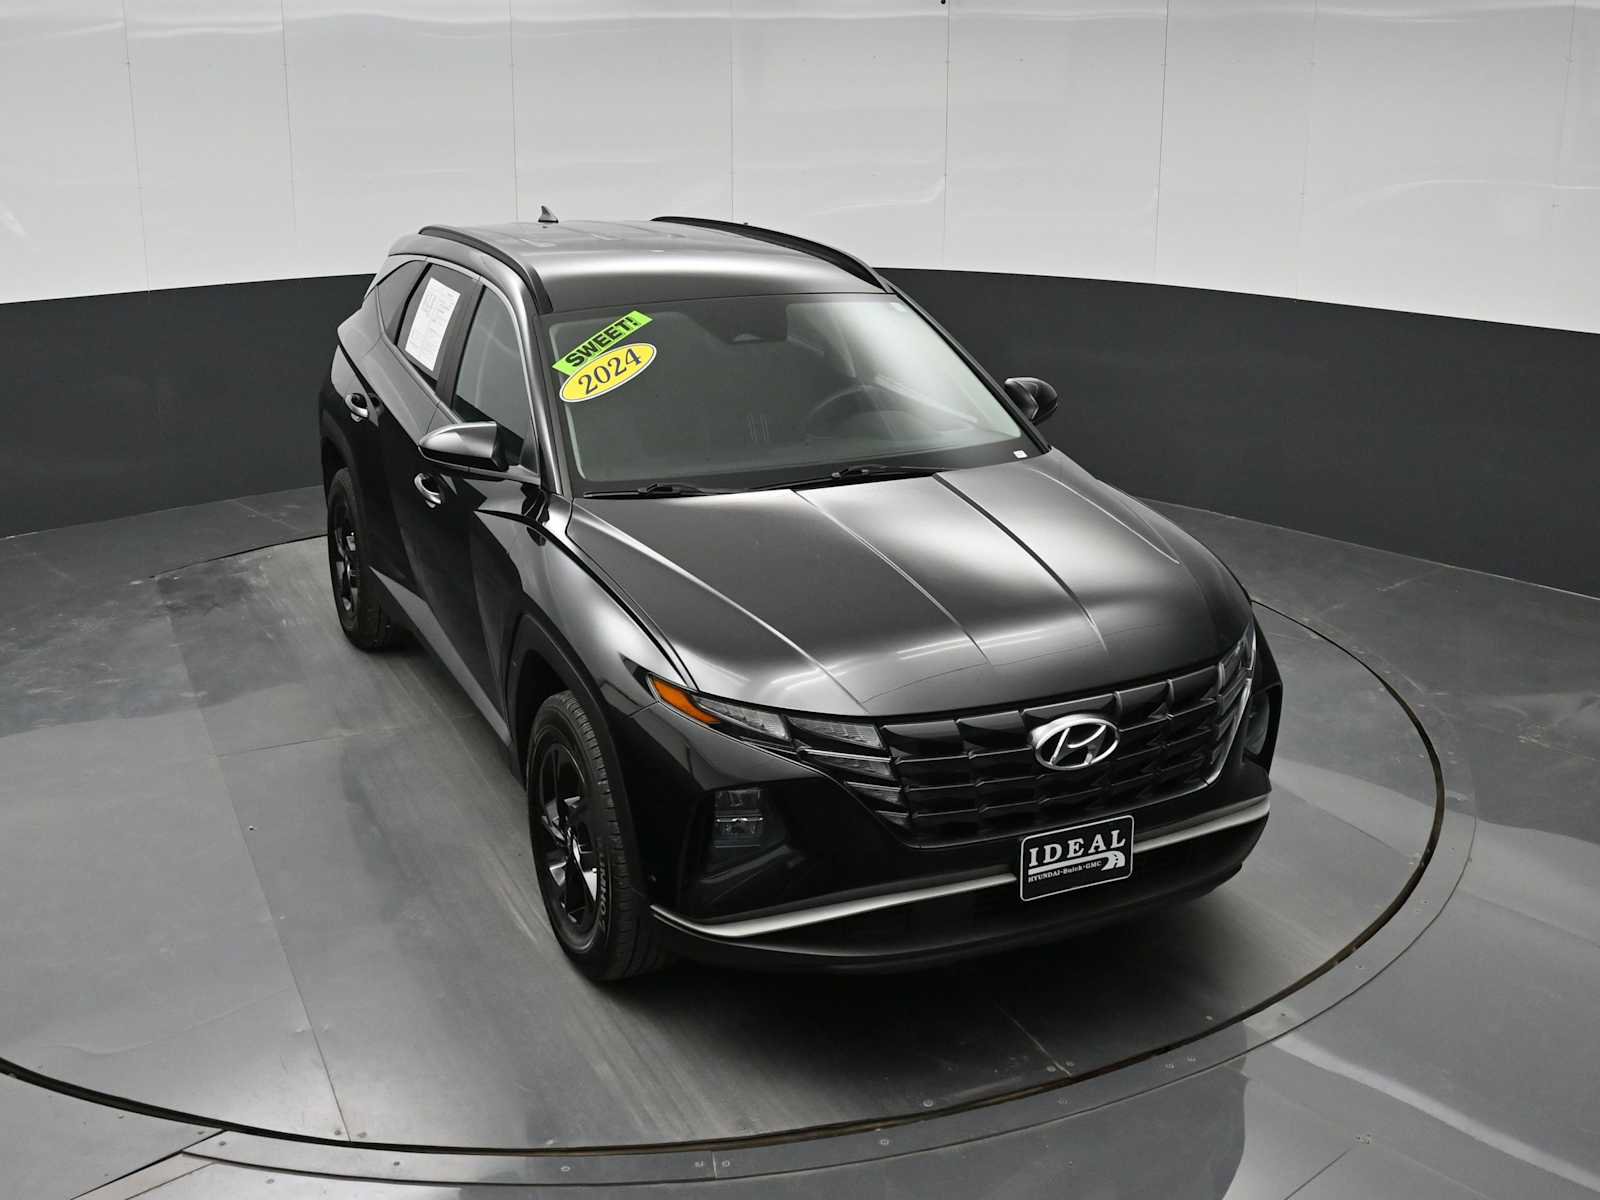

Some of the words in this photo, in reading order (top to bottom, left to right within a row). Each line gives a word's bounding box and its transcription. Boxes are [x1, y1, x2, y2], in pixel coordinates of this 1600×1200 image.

[565, 316, 638, 367] SWEET!
[578, 348, 643, 395] 2024
[1028, 829, 1126, 868] IDEAL
